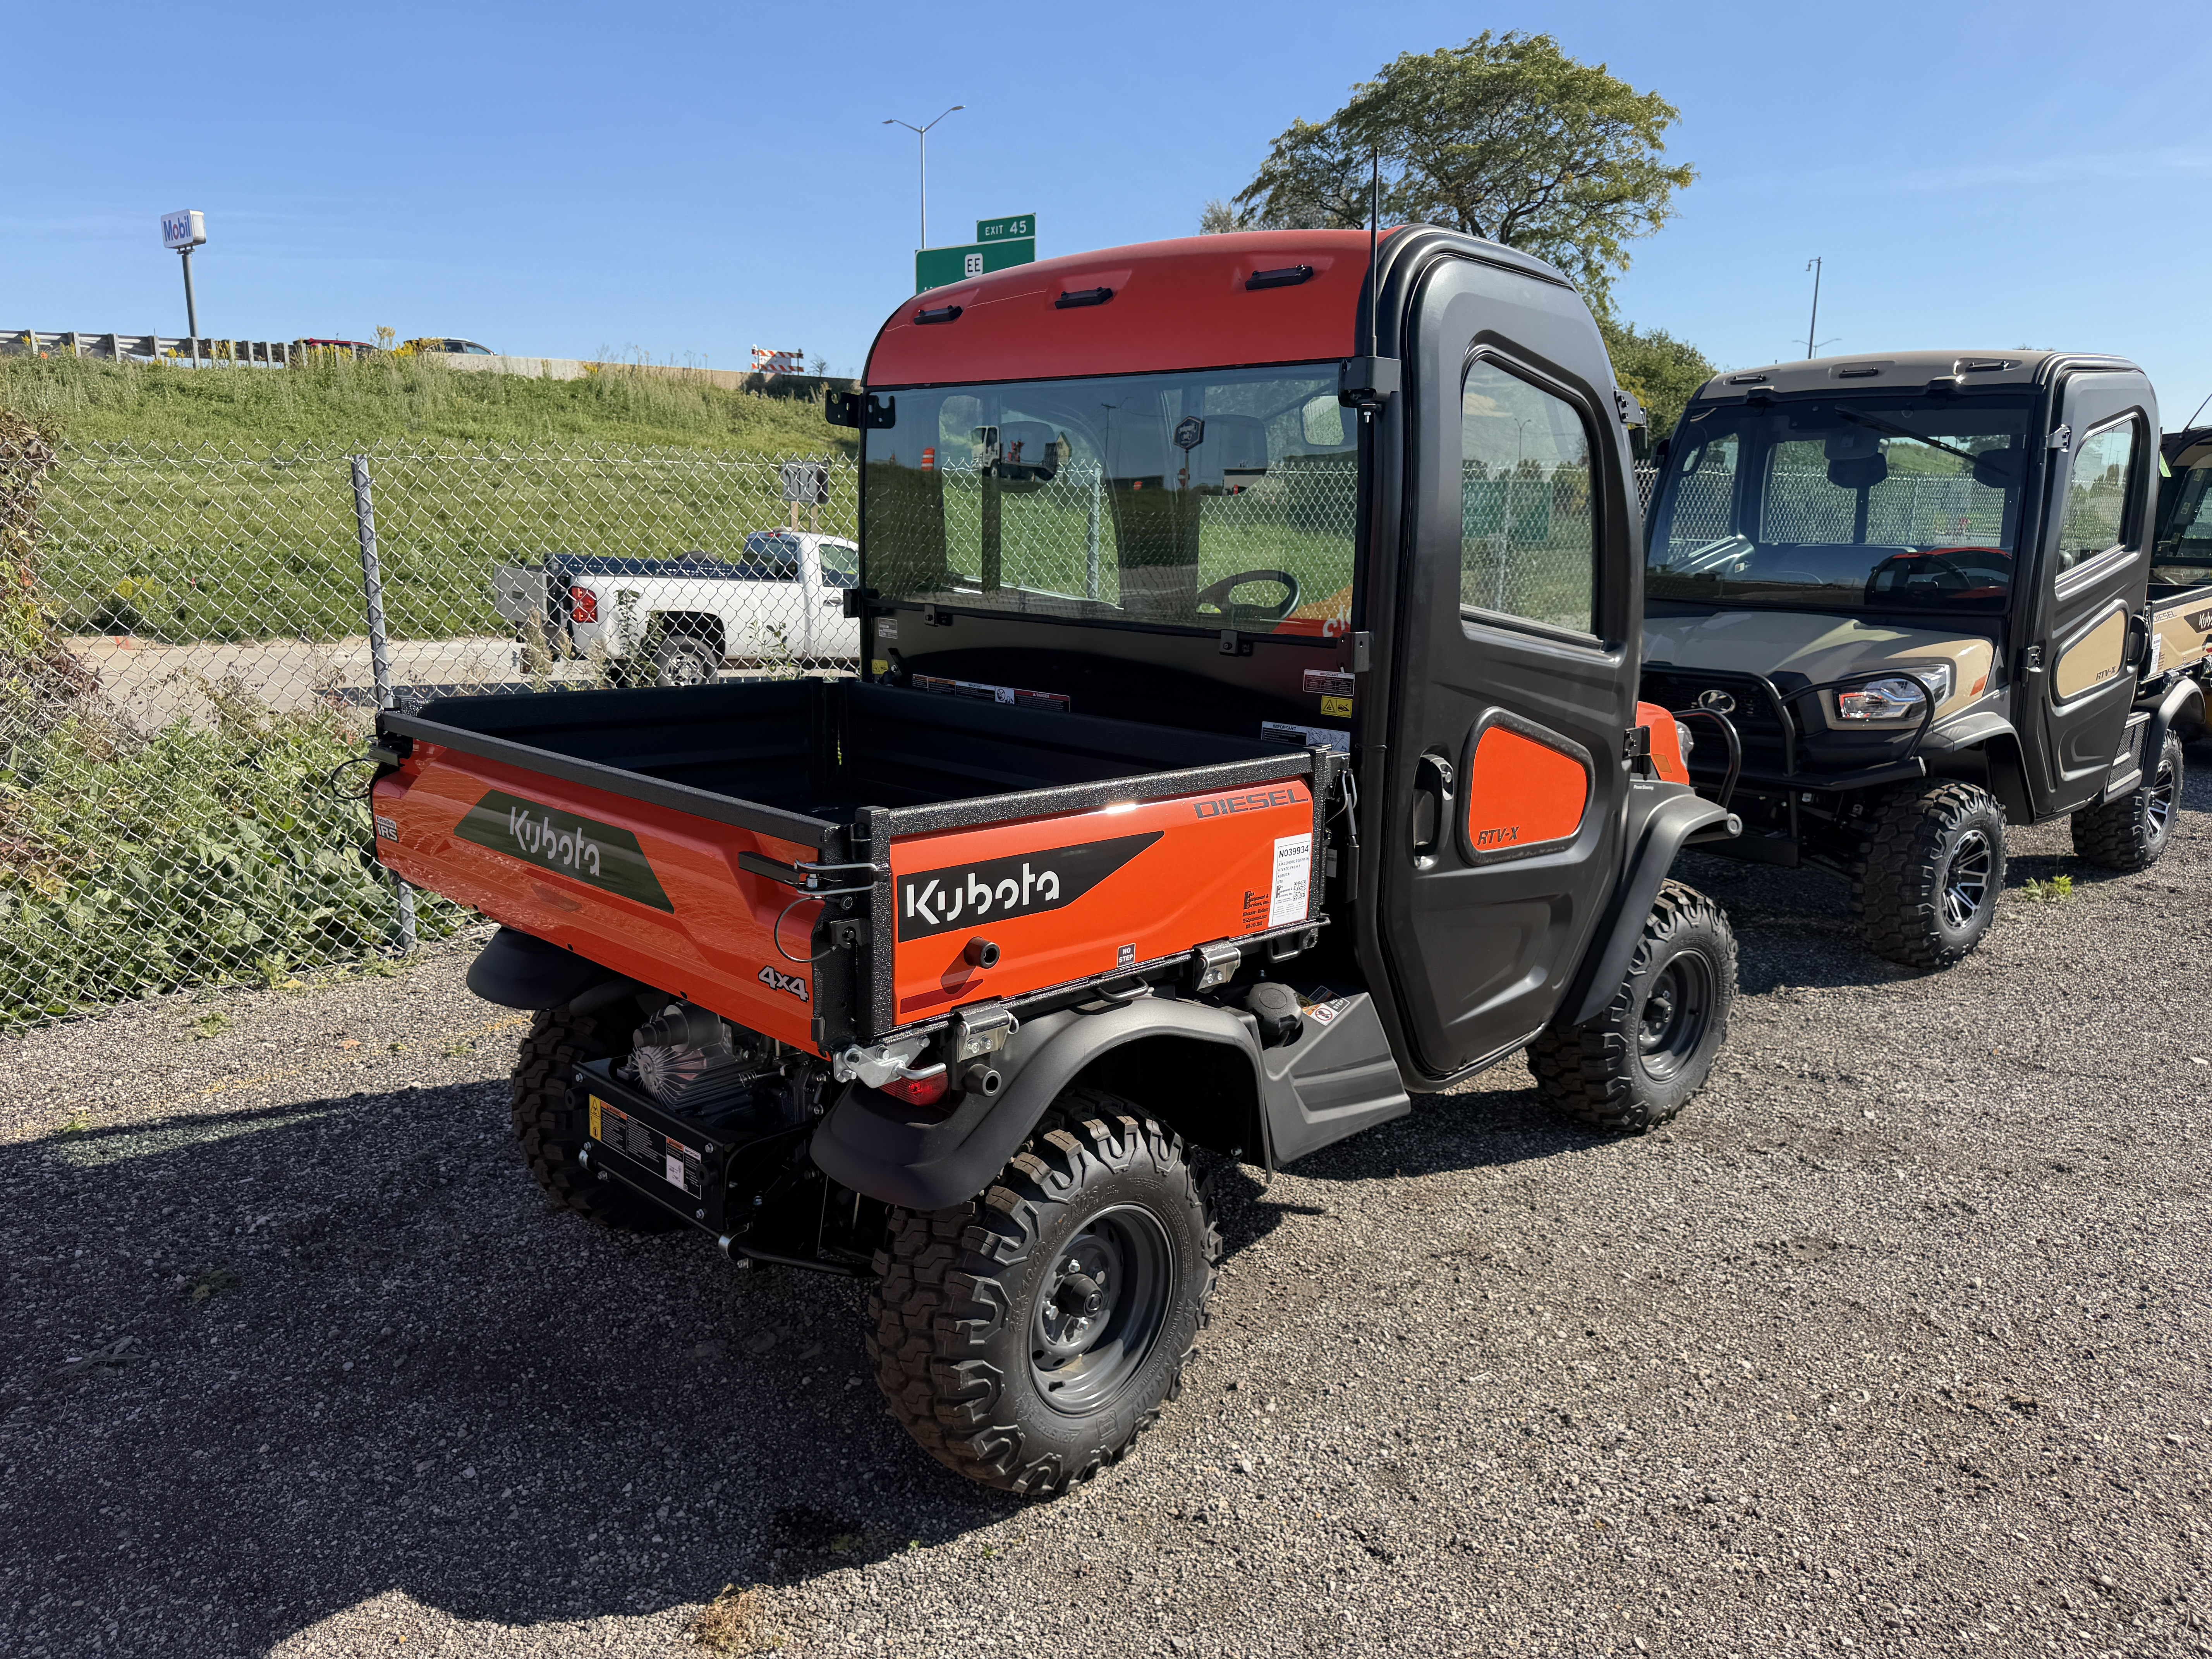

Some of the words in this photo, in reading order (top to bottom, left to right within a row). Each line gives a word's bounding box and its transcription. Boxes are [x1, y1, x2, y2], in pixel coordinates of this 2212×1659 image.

[163, 215, 191, 242] Mobil
[985, 225, 1003, 235] EXIT
[1010, 220, 1027, 234] 45
[967, 258, 981, 272] EE
[2096, 666, 2116, 681] RTV-X
[1194, 789, 1308, 819] DIESEL
[377, 824, 398, 841] IRS
[510, 806, 600, 876] Kubota
[1478, 826, 1519, 846] RTV-X
[1279, 845, 1309, 858] N039934
[907, 862, 1060, 925] Kubota
[1118, 954, 1133, 963] STEP
[759, 965, 808, 1002] 4x4
[1333, 1000, 1343, 1009] STEP
[1131, 1331, 1188, 1421] TERRAIN
